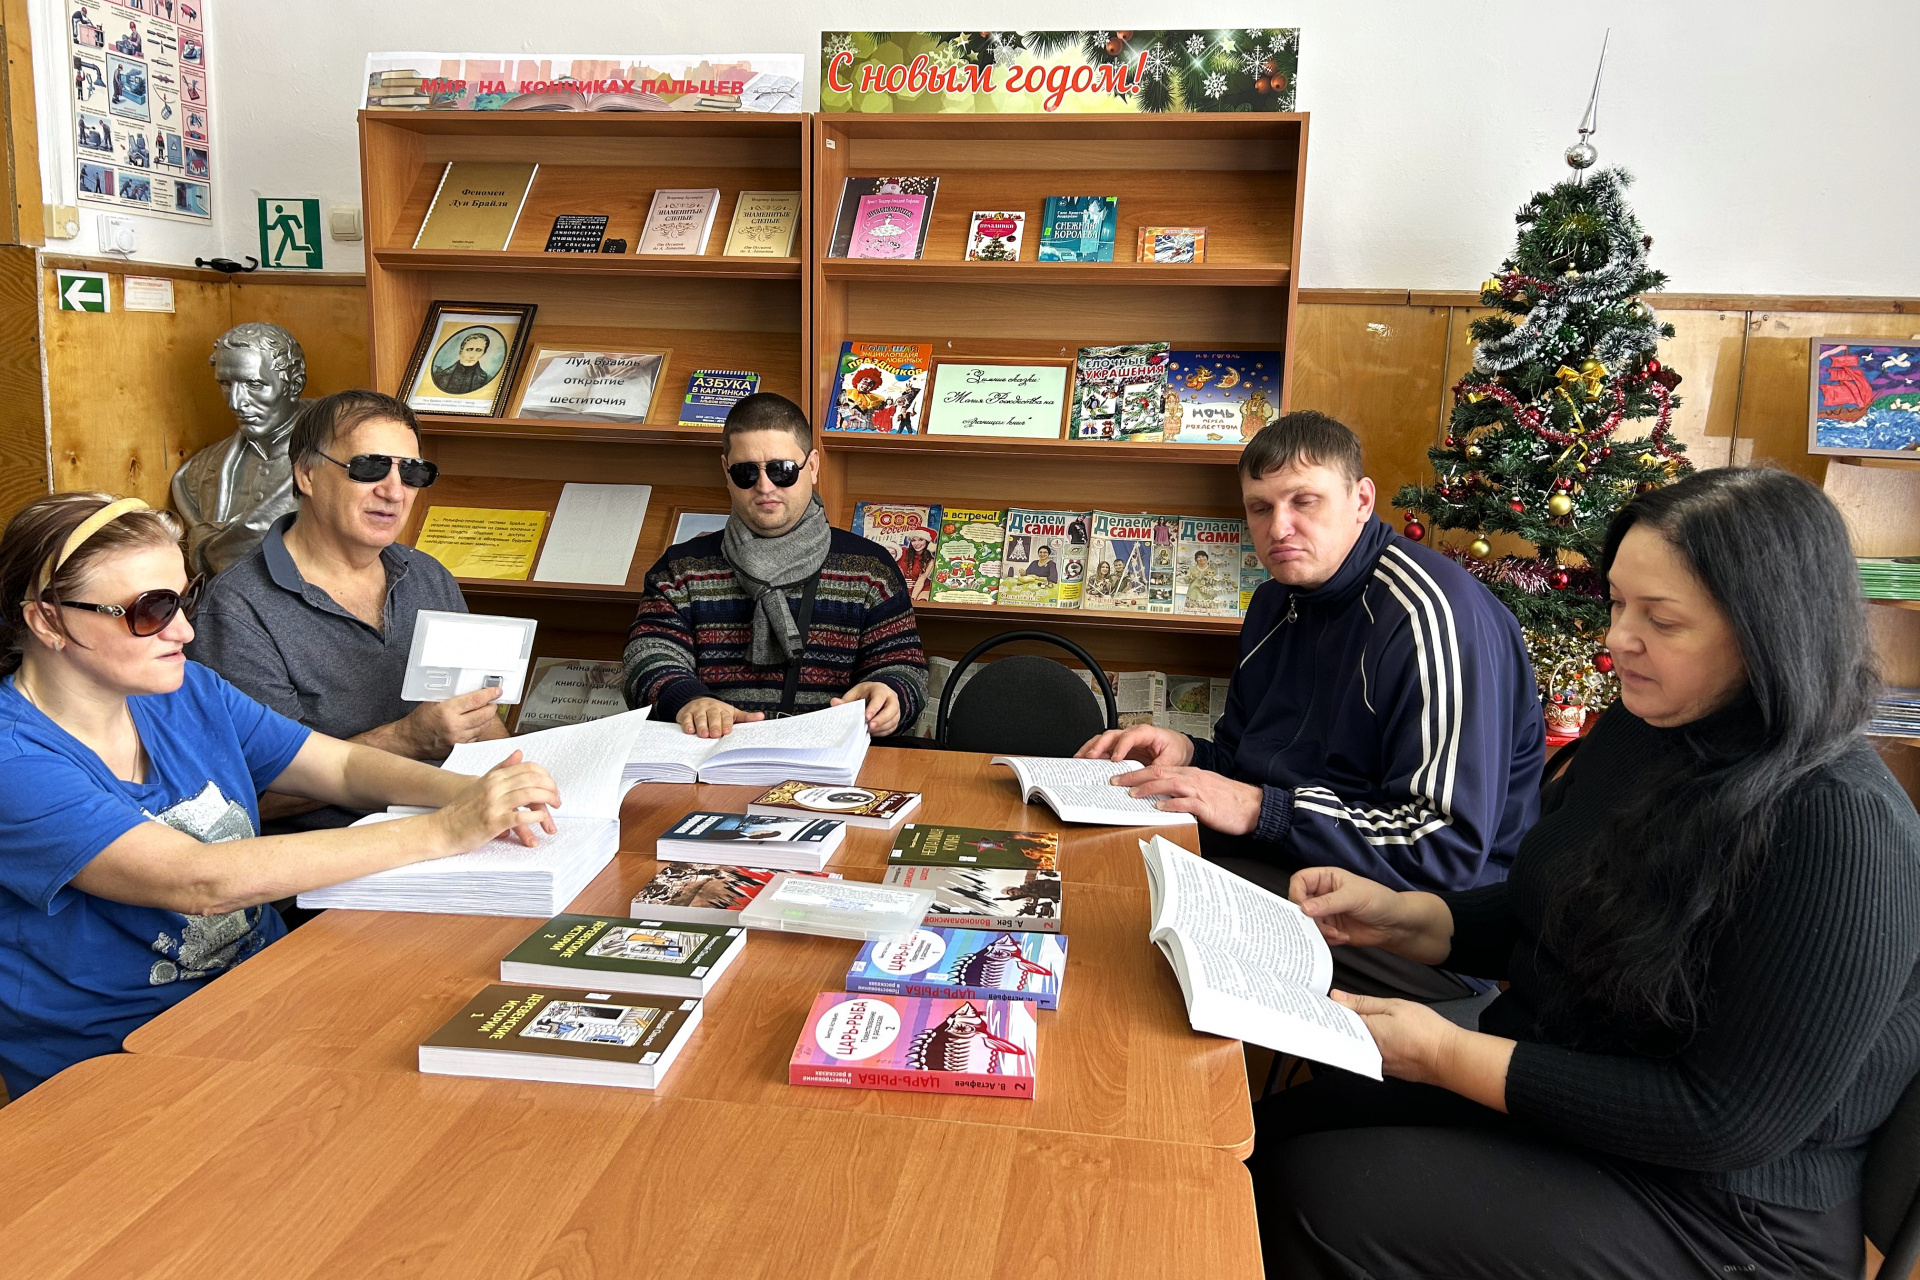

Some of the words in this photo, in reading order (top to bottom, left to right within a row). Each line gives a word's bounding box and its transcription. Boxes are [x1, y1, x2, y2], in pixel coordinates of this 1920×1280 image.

[828, 51, 853, 93] С
[862, 52, 996, 93] новым
[1005, 51, 1148, 112] годом!
[420, 79, 467, 94] МИР
[478, 80, 507, 95] НА
[520, 80, 635, 96] КОНЧИКАХ
[640, 80, 745, 97] ПАЛЬЦЕВ
[461, 189, 505, 197] Феномен
[449, 199, 469, 208] Луи
[471, 200, 508, 208] Брайля
[1054, 230, 1098, 239] КОРОЛЕВА
[565, 357, 591, 366] Луи
[594, 356, 641, 367] Брайль
[848, 357, 923, 376] ПРАЗДНИКОВ
[1085, 356, 1146, 368] ЕЛОЧНЫЕ
[1085, 365, 1164, 379] УКРАШЕНИЯ
[563, 377, 625, 387] открытие
[694, 377, 752, 390] АЗБУКА
[700, 387, 751, 397] КАРТИНКАХ
[550, 396, 626, 406] шеститочия
[1192, 408, 1235, 419] НОЧЬ
[866, 507, 922, 529] 1000
[951, 512, 998, 522] встреча!
[1009, 513, 1066, 534] Делаем
[1094, 515, 1151, 536] Делаем
[1024, 523, 1065, 536] сами
[1110, 527, 1151, 539] сами
[1180, 521, 1240, 542] Делаем
[1197, 531, 1240, 544] сами
[566, 664, 591, 673] Анна
[551, 696, 589, 705] русской
[591, 699, 619, 707] книги
[538, 712, 577, 722] системе
[924, 916, 991, 927] Волоколамское
[996, 919, 1013, 928] Бек
[1014, 920, 1024, 929] А.
[1044, 921, 1054, 929] 2
[550, 925, 588, 951] ИСТОРИИ
[559, 920, 608, 959] ДЕРЕВЕНСКИЕ
[905, 984, 976, 1000] ЦАРЬ-РЫБА
[477, 1000, 521, 1033] ИСТОРИИ
[489, 993, 545, 1041] ДЕРЕВЕНСКИЕ
[835, 1000, 869, 1056] ЦАРЬ-РЫБА
[814, 1070, 847, 1078] рассказах
[802, 1076, 852, 1085] Повествование
[857, 1073, 940, 1089] ЦАРЬ-РЫБА
[954, 1080, 996, 1090] Астафьев
[1000, 1082, 1006, 1091] В.
[1014, 1083, 1027, 1091] 2
